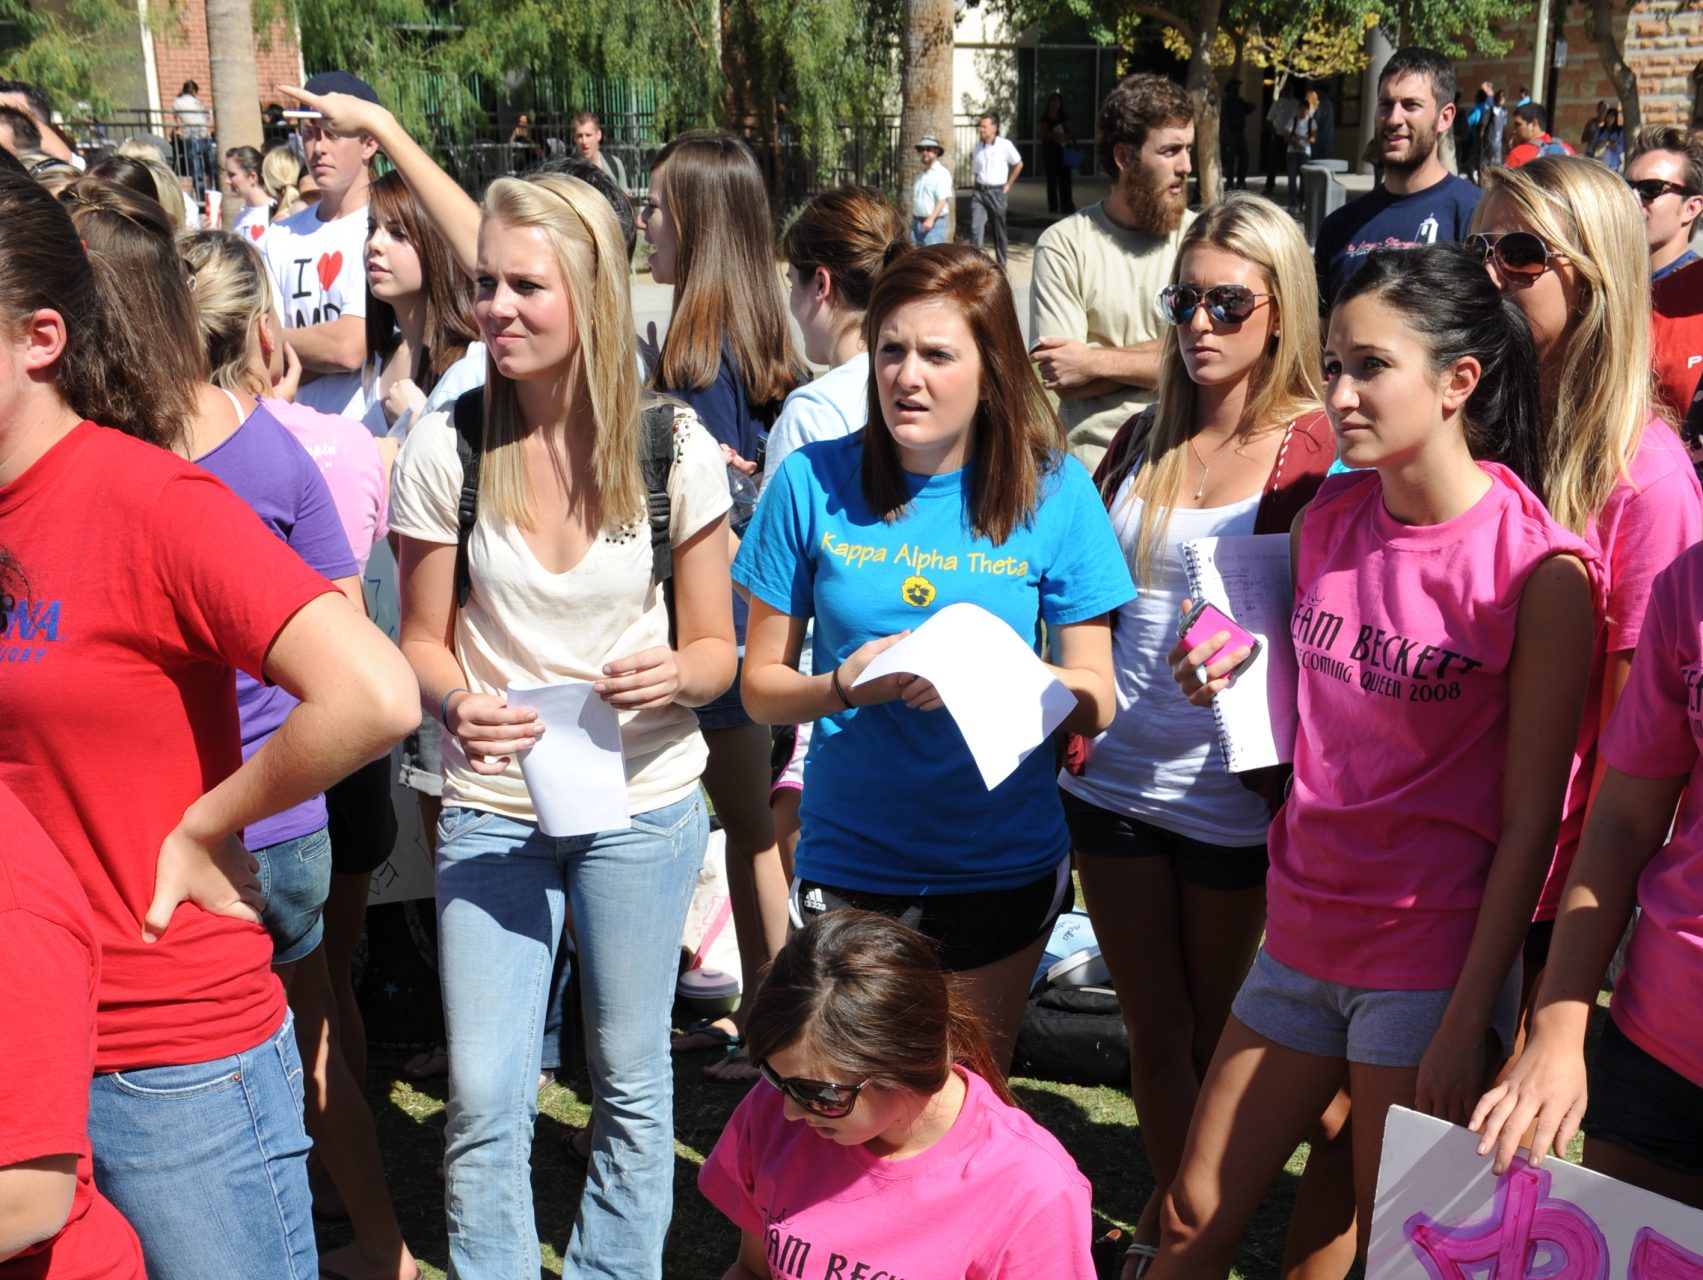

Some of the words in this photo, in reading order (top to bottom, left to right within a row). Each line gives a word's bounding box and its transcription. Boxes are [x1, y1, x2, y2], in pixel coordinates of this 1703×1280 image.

[292, 257, 313, 299] I
[820, 531, 887, 569] Kappa
[893, 543, 959, 577] Alpha
[967, 552, 1030, 577] Theta
[1350, 623, 1484, 681] BECKETT
[1360, 670, 1402, 700] QUEEN
[1409, 681, 1461, 703] 2008
